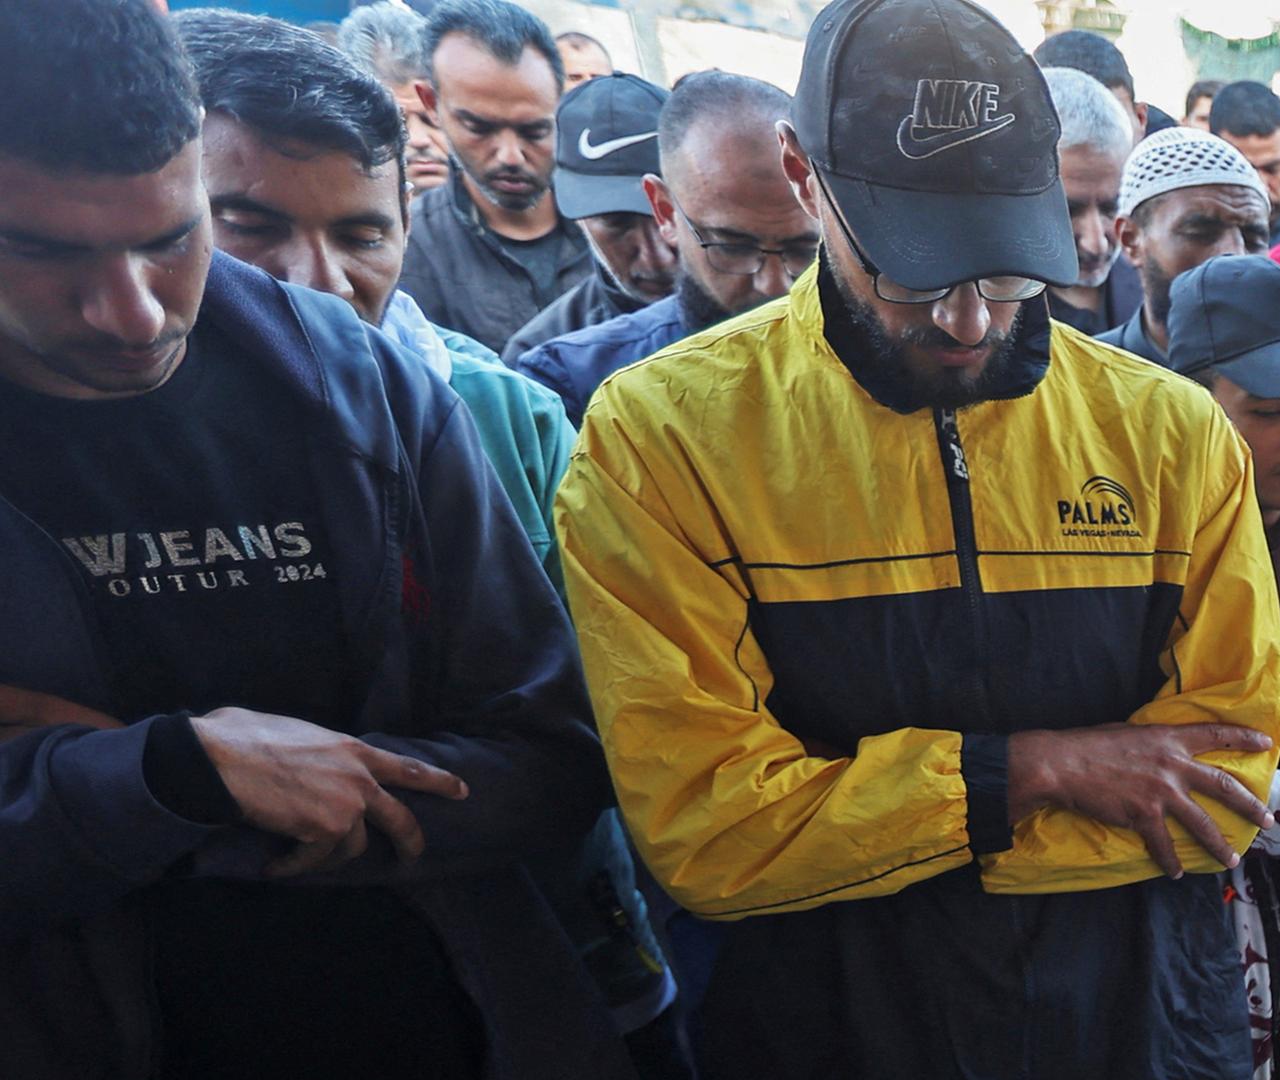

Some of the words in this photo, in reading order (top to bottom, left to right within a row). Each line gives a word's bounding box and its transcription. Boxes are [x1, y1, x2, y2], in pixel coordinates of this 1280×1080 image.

[912, 78, 1000, 129] NIKE
[1057, 500, 1131, 525] PALMS
[137, 522, 312, 568] JEANS
[1062, 529, 1079, 537] LAS
[1080, 529, 1107, 538] VEGAS
[1111, 530, 1142, 538] NEVADA
[273, 562, 327, 583] 2024
